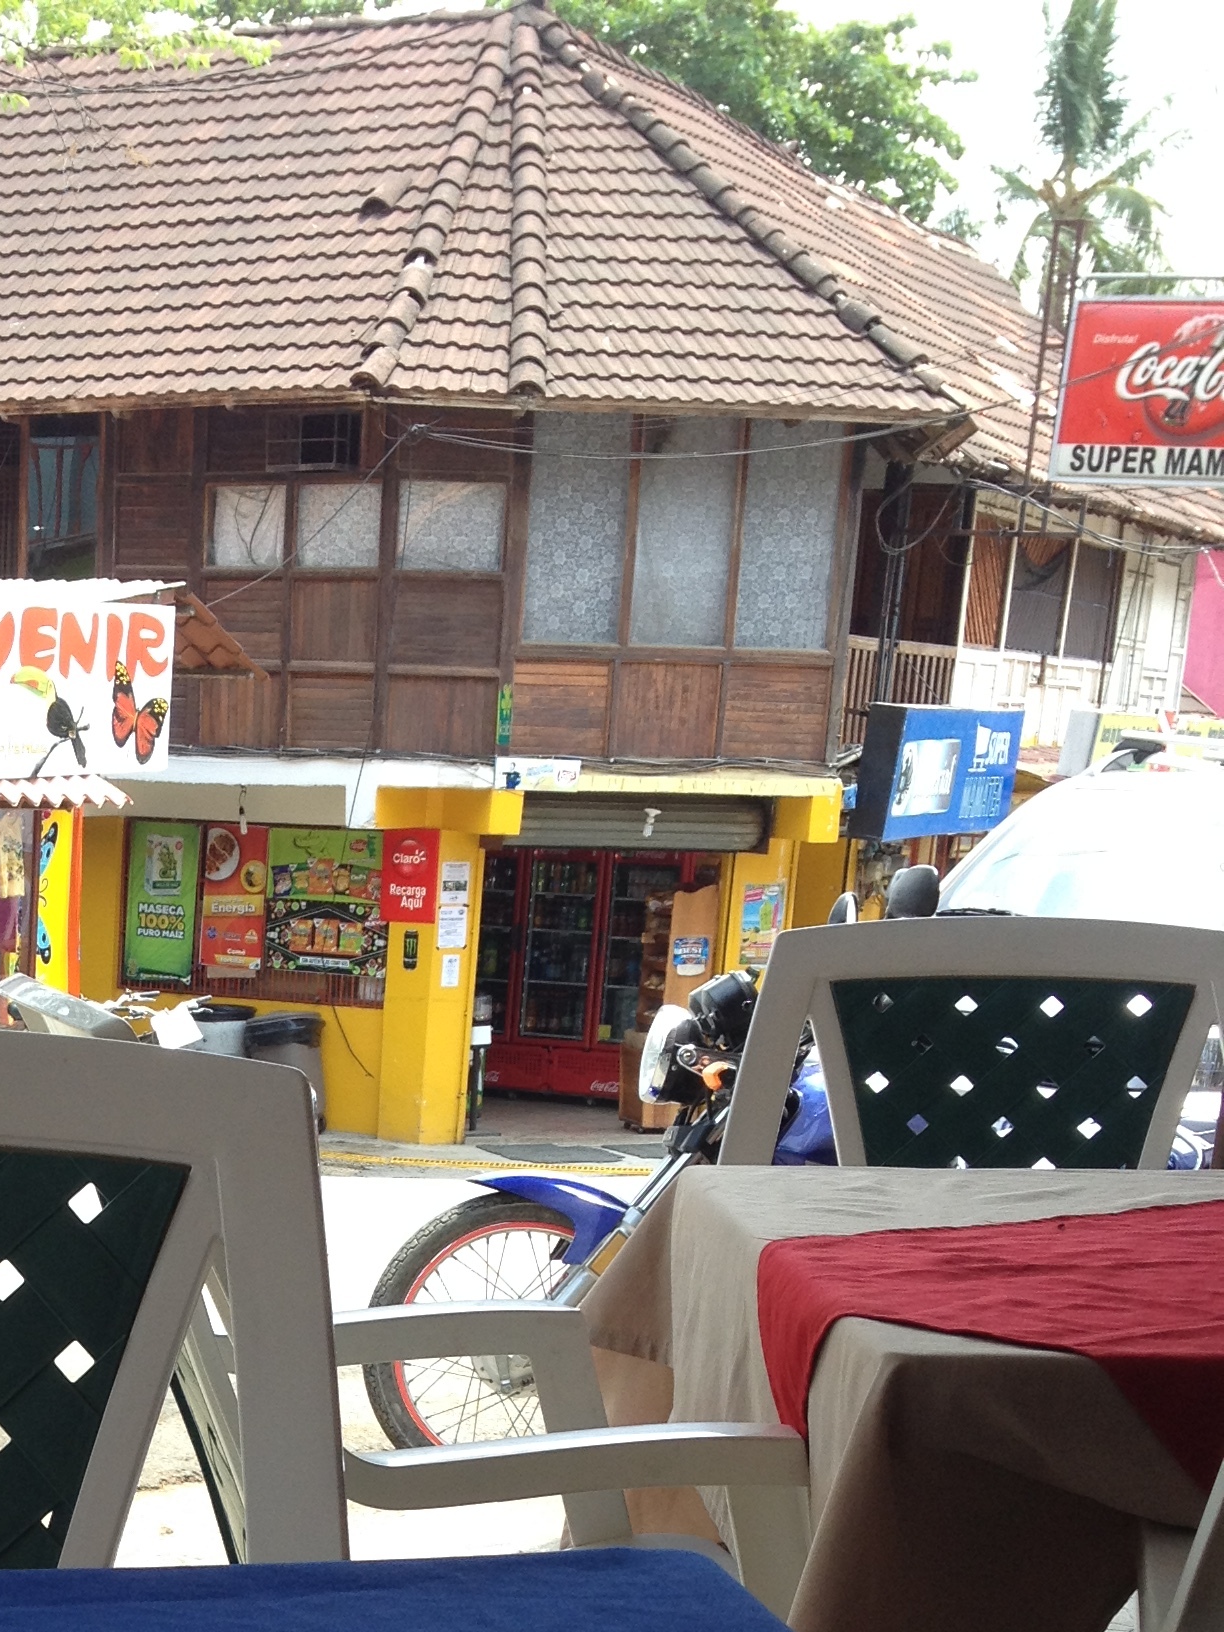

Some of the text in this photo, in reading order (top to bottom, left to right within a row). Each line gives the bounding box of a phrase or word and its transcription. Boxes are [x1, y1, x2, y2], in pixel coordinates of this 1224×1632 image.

[1069, 443, 1157, 475] SUPER
[392, 850, 421, 864] Claro
[389, 883, 427, 899] Recarga
[138, 902, 185, 916] MASECA
[139, 913, 185, 931] 100%
[137, 927, 161, 937] PURO
